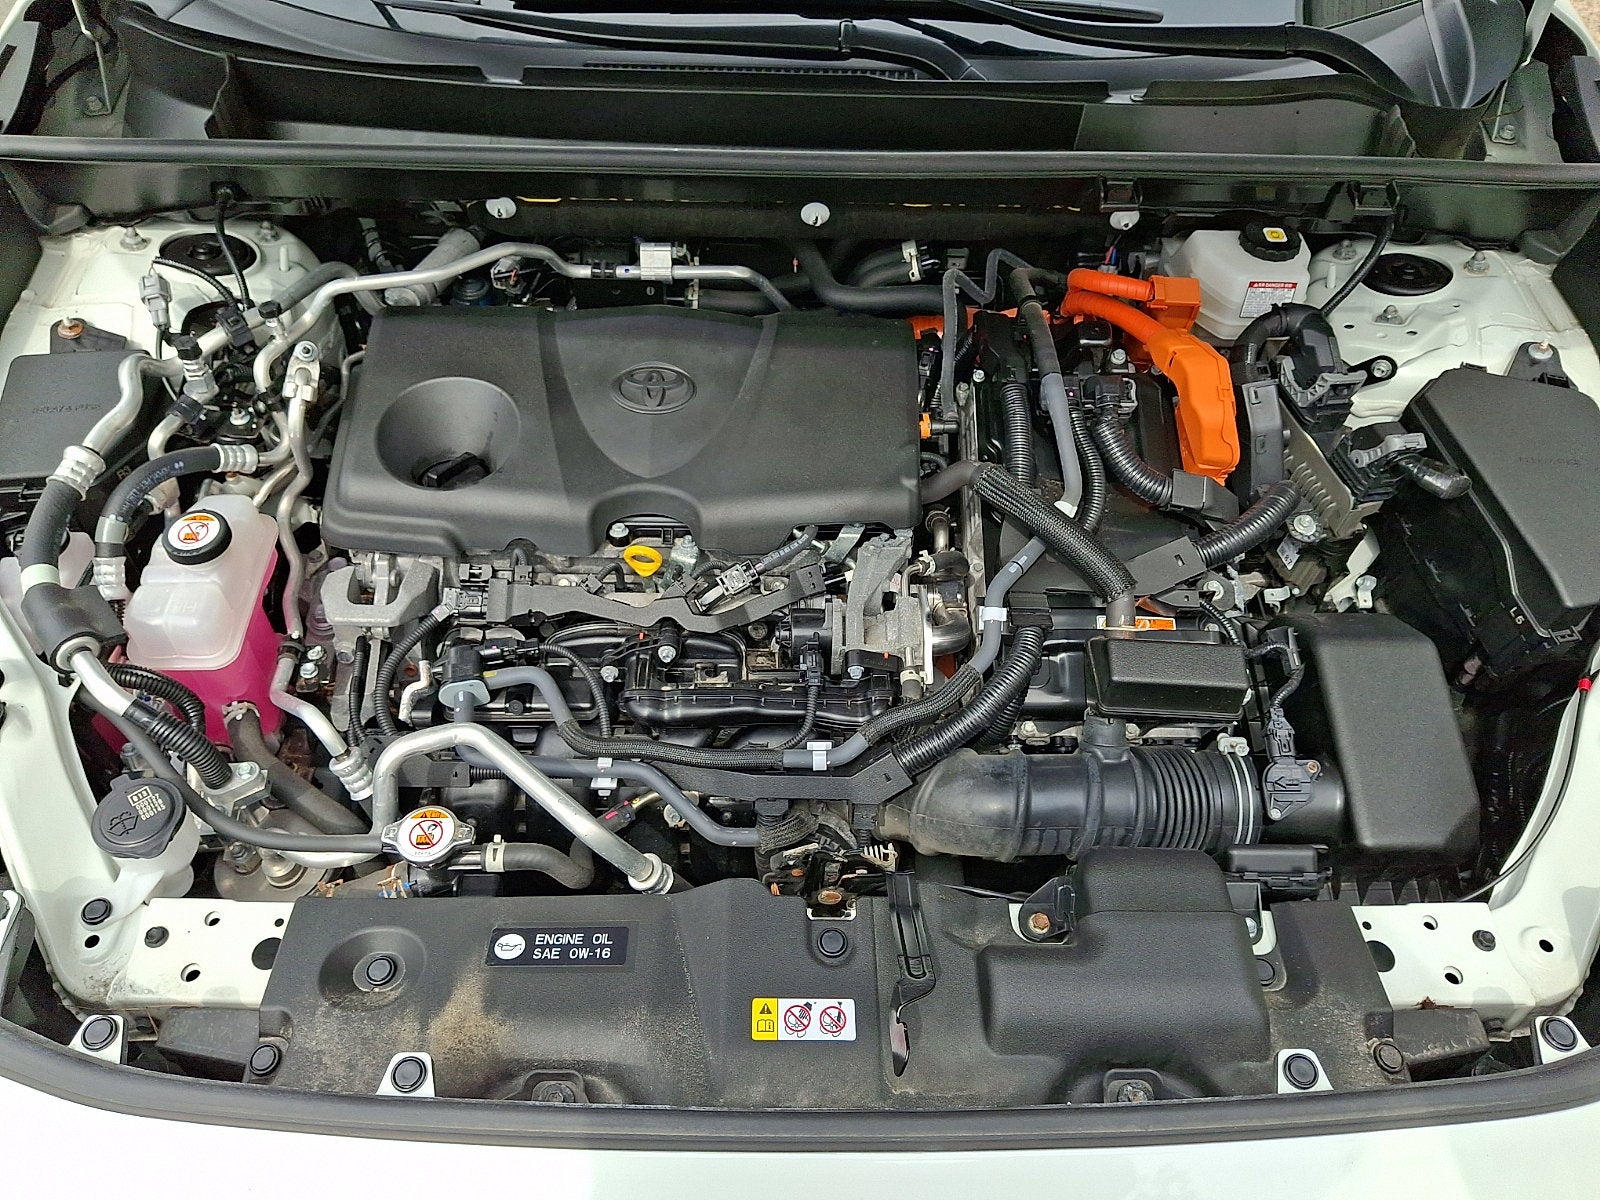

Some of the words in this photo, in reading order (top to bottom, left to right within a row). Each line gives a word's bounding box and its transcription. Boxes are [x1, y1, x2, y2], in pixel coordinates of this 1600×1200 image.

[1510, 606, 1525, 625] L6
[140, 804, 166, 821] 000145
[535, 933, 585, 945] ENGINE
[592, 933, 614, 945] OIL
[532, 947, 562, 960] SAE
[569, 947, 611, 959] 0W-16
